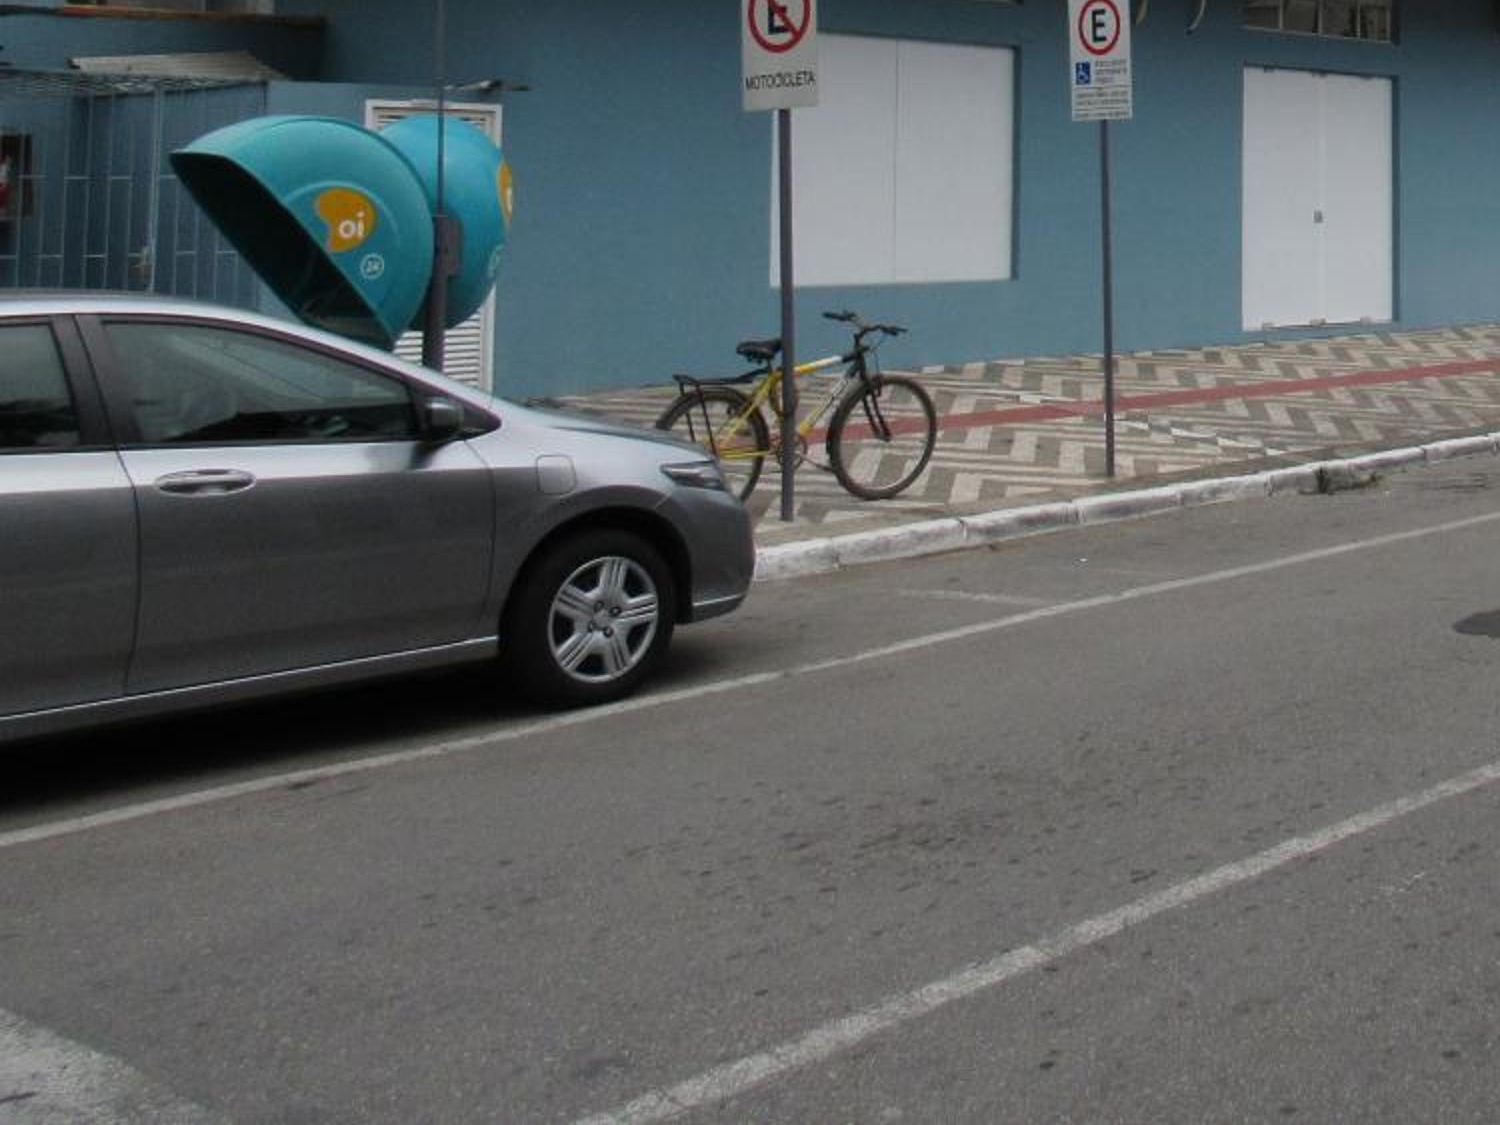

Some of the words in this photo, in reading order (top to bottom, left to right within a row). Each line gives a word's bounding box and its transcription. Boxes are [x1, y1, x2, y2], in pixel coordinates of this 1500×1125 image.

[1091, 8, 1107, 43] E
[745, 71, 817, 91] MOTOCICLETA
[339, 210, 365, 239] oi
